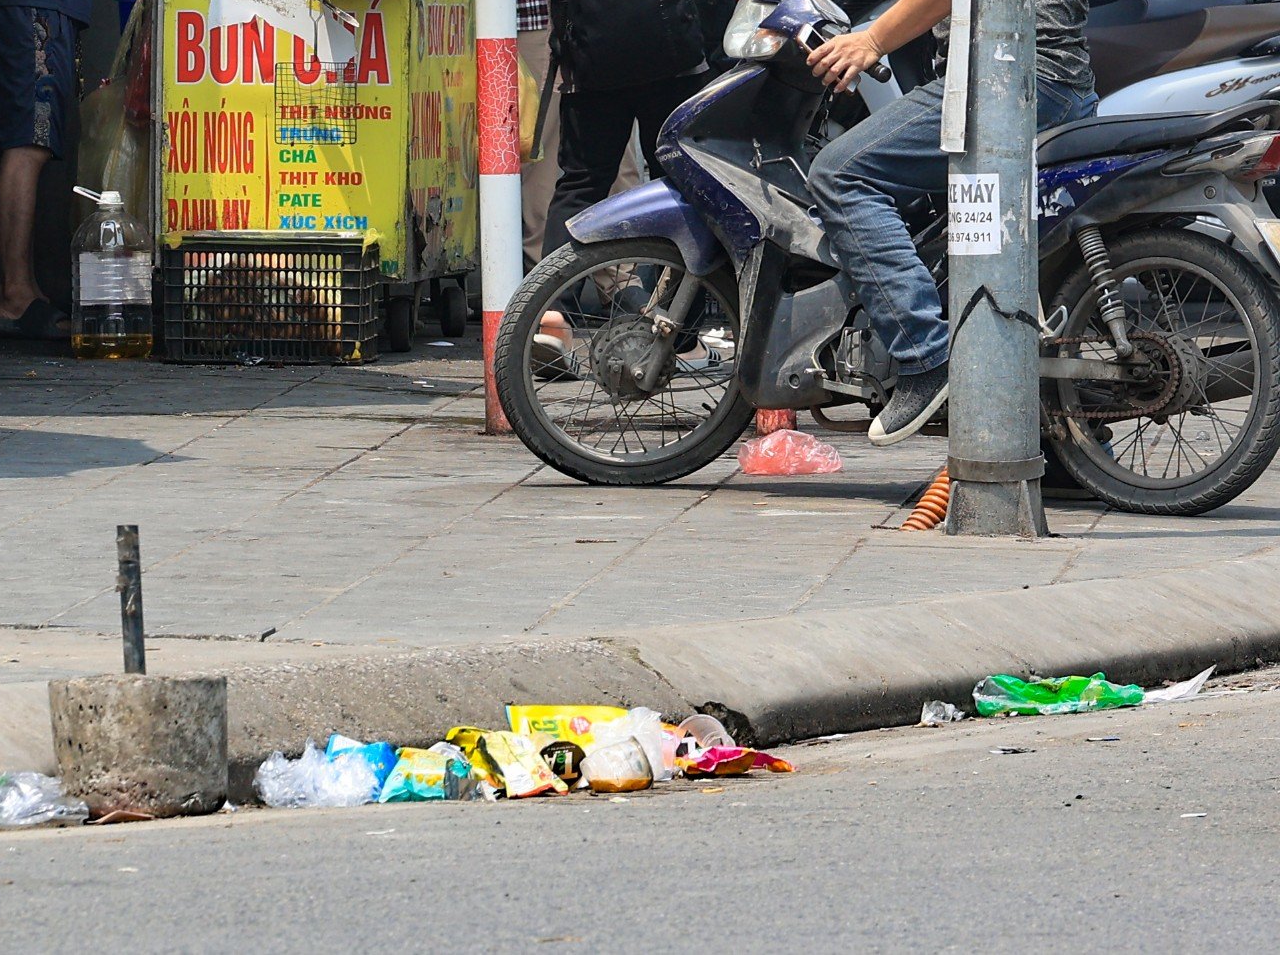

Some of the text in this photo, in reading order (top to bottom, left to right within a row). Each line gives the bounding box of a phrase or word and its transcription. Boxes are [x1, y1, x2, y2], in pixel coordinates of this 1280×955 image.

[279, 103, 391, 122] THỊT NƯỚNG
[168, 98, 254, 174] XÔI NÓNG
[279, 145, 317, 164] CHẢ
[279, 171, 363, 188] THỊT KHO
[961, 179, 995, 204] MÁY
[279, 194, 322, 208] PATE
[279, 213, 368, 230] XÚC XÍCH
[964, 212, 993, 224] 24/24
